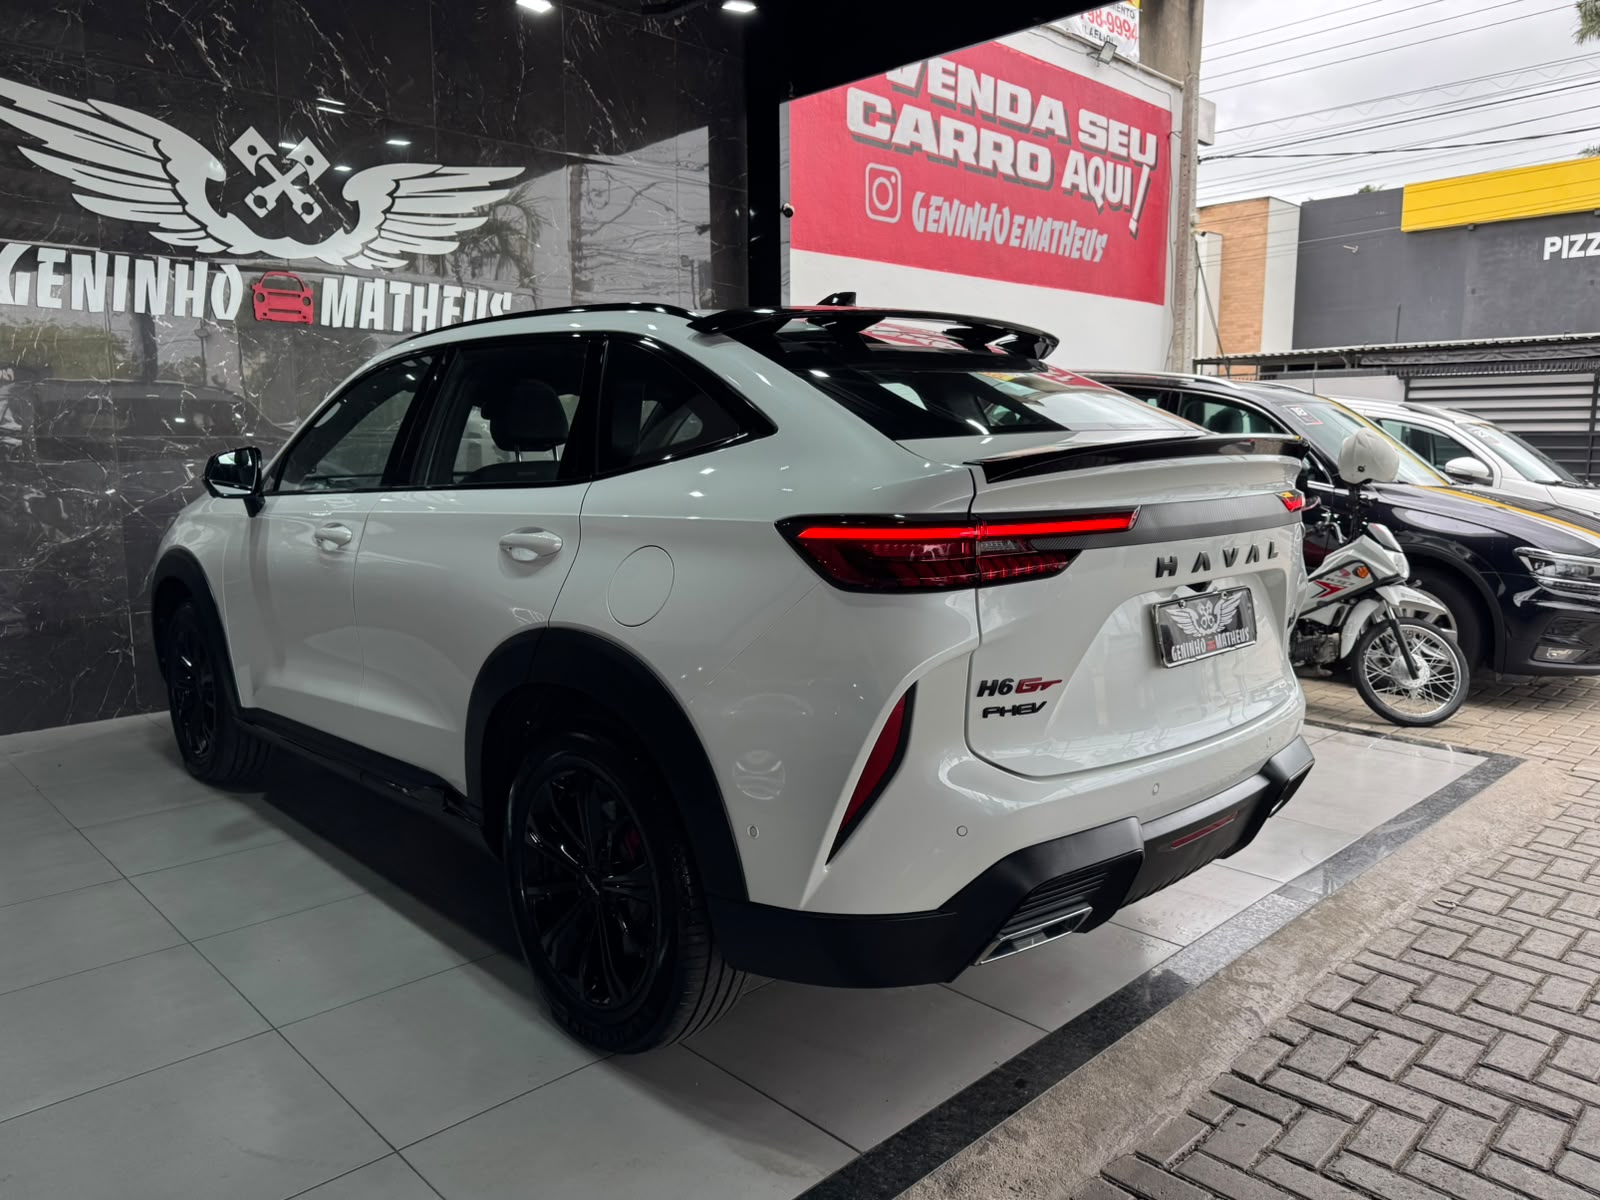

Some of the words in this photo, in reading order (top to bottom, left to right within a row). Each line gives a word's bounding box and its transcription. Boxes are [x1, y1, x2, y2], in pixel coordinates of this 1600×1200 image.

[1078, 108, 1156, 166] SEU
[846, 86, 1052, 184] CARRO
[1061, 150, 1149, 233] AQUI!
[1543, 231, 1600, 261] PIZZ
[0, 243, 243, 321] GENINHO
[320, 275, 512, 333] MATHEUS
[1155, 541, 1279, 578] HAVAL
[1171, 638, 1206, 661] GENINHO
[1215, 627, 1249, 649] MATHEUS
[982, 701, 1047, 718] PHEV
